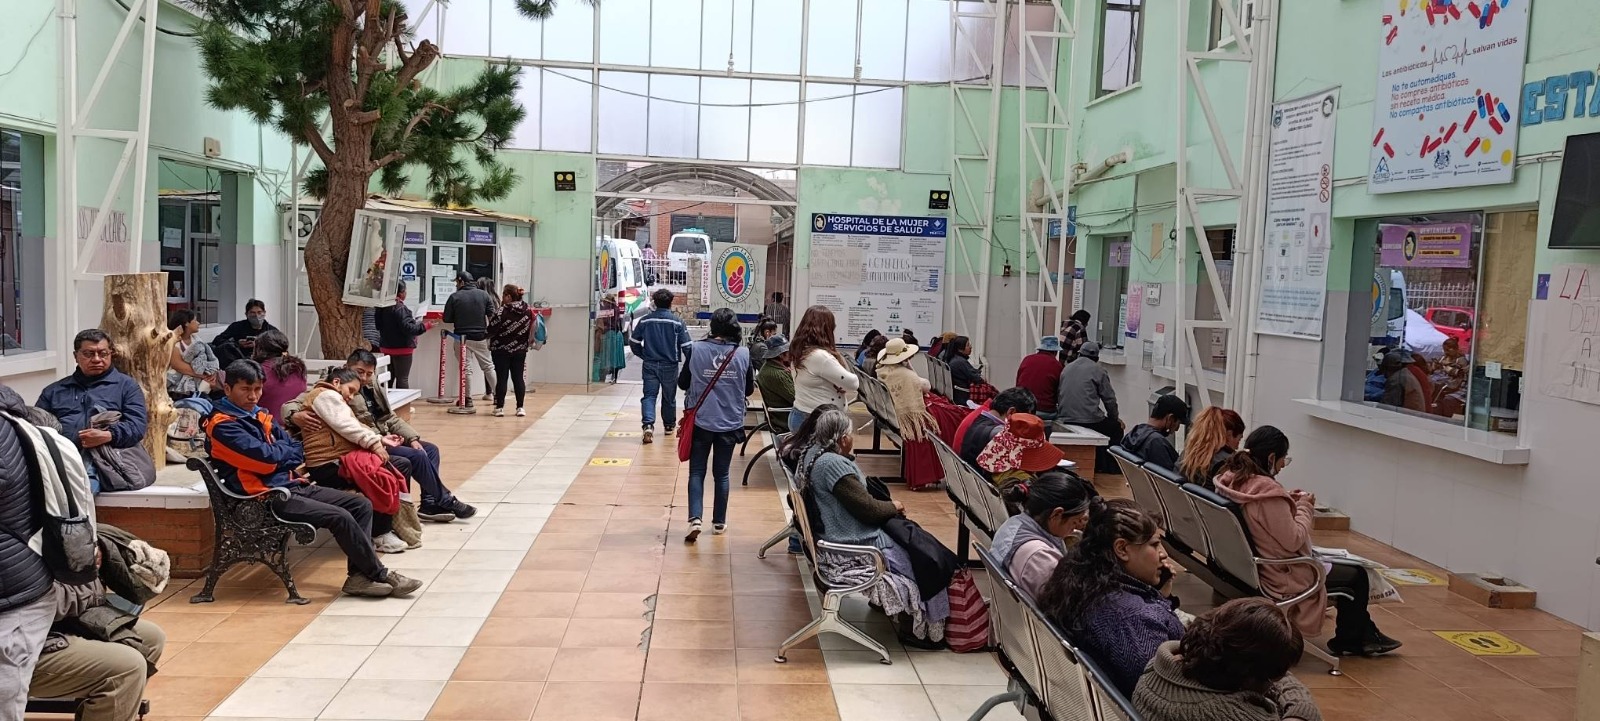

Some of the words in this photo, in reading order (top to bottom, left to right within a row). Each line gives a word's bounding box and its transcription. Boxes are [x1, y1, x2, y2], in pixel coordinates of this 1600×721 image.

[1382, 70, 1392, 78] Los
[1472, 43, 1495, 55] salvan
[1498, 36, 1518, 48] vidas
[1391, 84, 1400, 92] No
[1401, 82, 1409, 90] te
[1410, 71, 1456, 87] automediques
[1391, 93, 1399, 101] No
[1400, 88, 1428, 100] compres
[1429, 78, 1469, 93] antibióticos
[1389, 110, 1398, 119] No
[1398, 103, 1433, 117] compartas
[1434, 96, 1475, 110] antibióticos
[1390, 102, 1399, 110] sin
[1399, 97, 1420, 108] receta
[1421, 92, 1445, 103] médica
[827, 215, 871, 225] HOSPITAL
[872, 217, 884, 226] DE
[886, 218, 897, 226] LA
[899, 218, 929, 227] MUJER
[832, 223, 878, 233] SERVICIOS
[880, 225, 892, 233] DE
[893, 225, 923, 234] SALUD
[1559, 268, 1592, 302] LA
